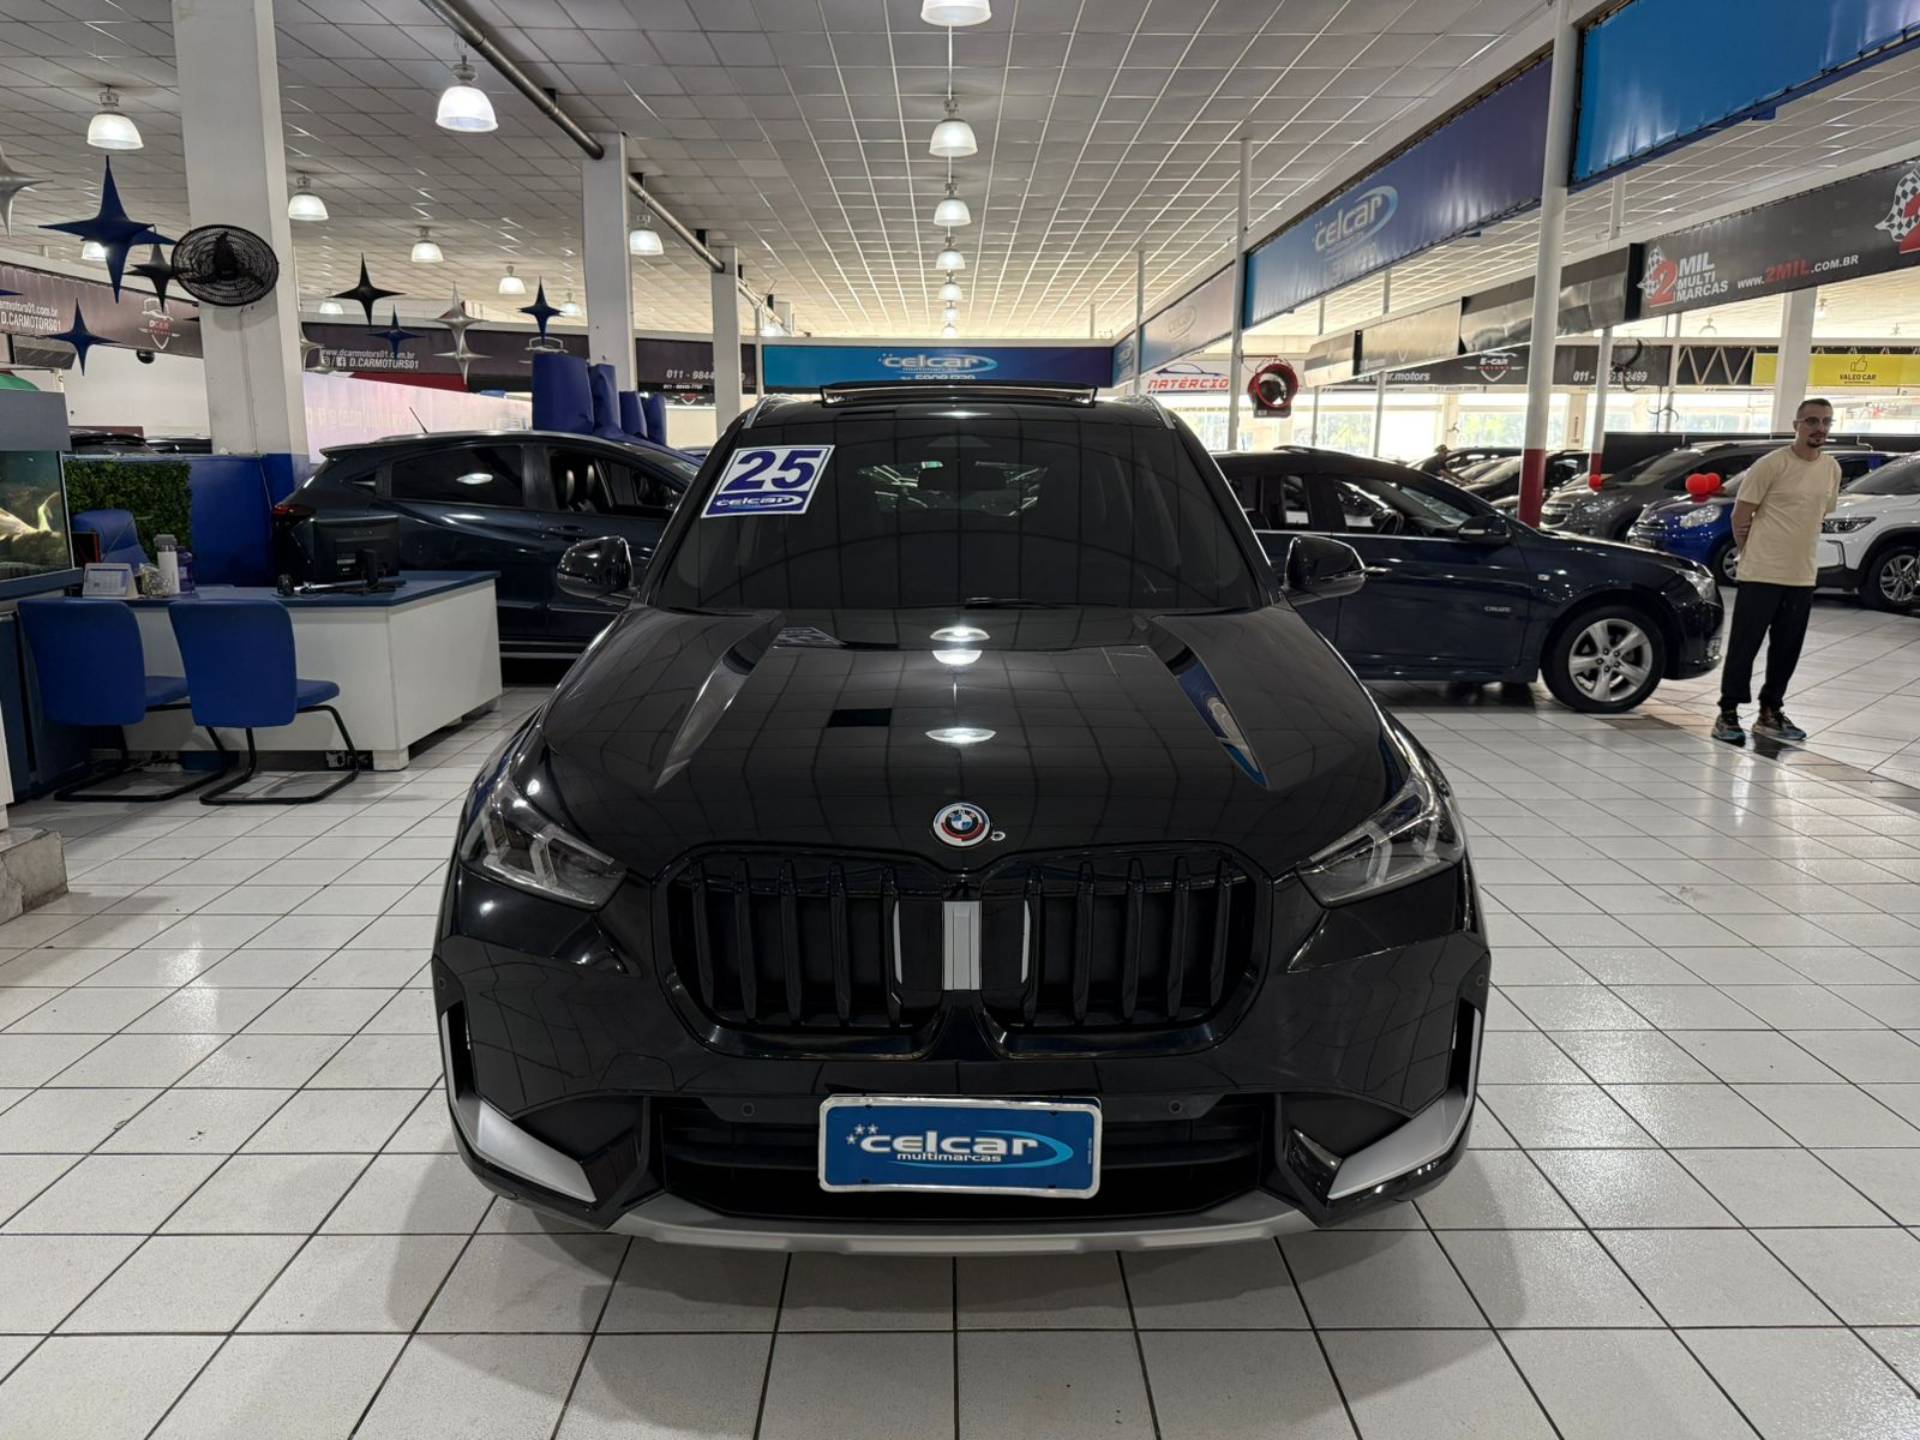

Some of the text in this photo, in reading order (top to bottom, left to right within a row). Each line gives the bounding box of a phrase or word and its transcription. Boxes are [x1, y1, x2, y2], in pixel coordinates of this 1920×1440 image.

[1314, 196, 1383, 252] celcar
[1679, 252, 1715, 277] MIL
[1676, 280, 1729, 302] MARCAS
[1677, 271, 1716, 291] MULTI
[884, 355, 979, 368] celcar
[666, 369, 684, 379] 011
[1573, 371, 1590, 381] 011
[722, 450, 822, 490] 25
[715, 497, 795, 507] celcar
[860, 1130, 1038, 1156] celcar
[896, 1151, 1002, 1163] multimarcas
